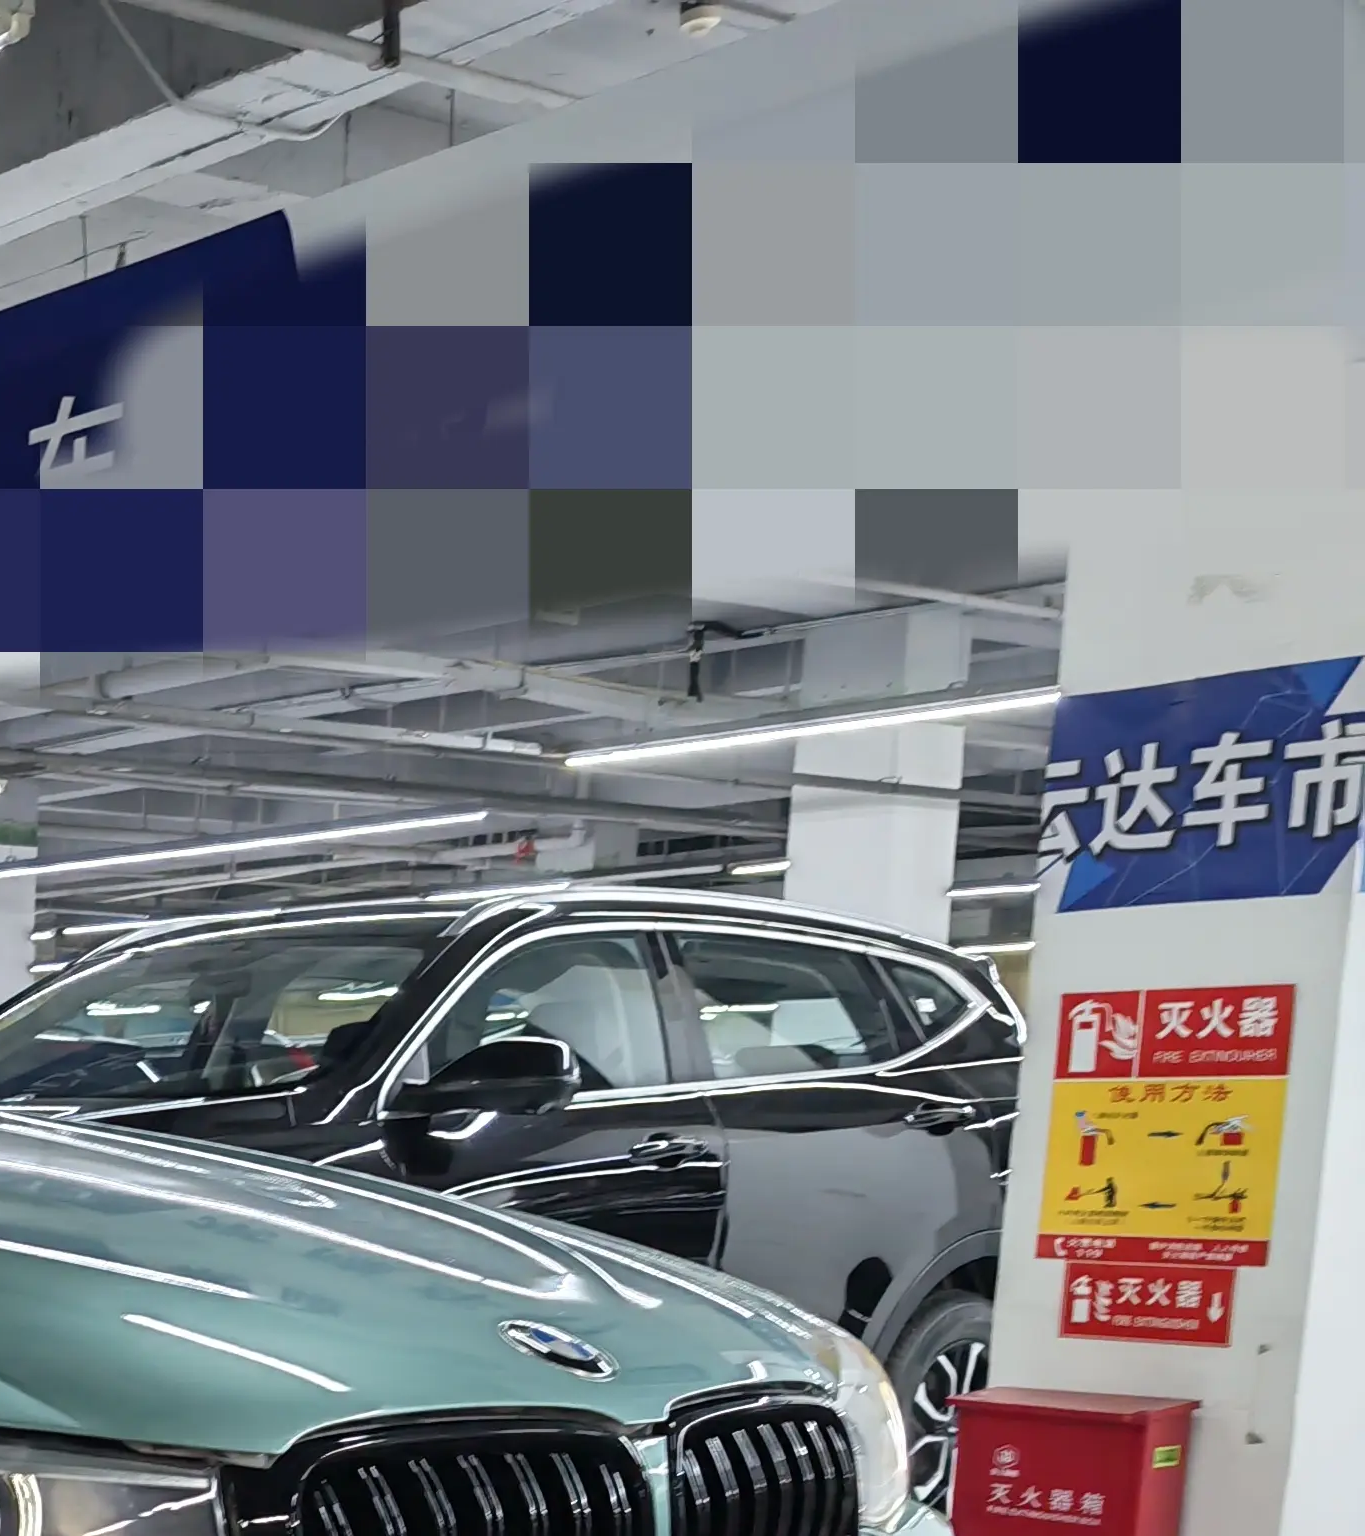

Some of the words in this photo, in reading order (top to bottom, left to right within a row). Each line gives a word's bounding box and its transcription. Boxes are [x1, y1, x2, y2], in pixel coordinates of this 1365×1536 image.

[1155, 997, 1278, 1040] 灭火器
[1108, 1083, 1233, 1103] 使用方法
[1116, 1277, 1203, 1308] 灭火器
[988, 1483, 1106, 1515] 灭火器箱
